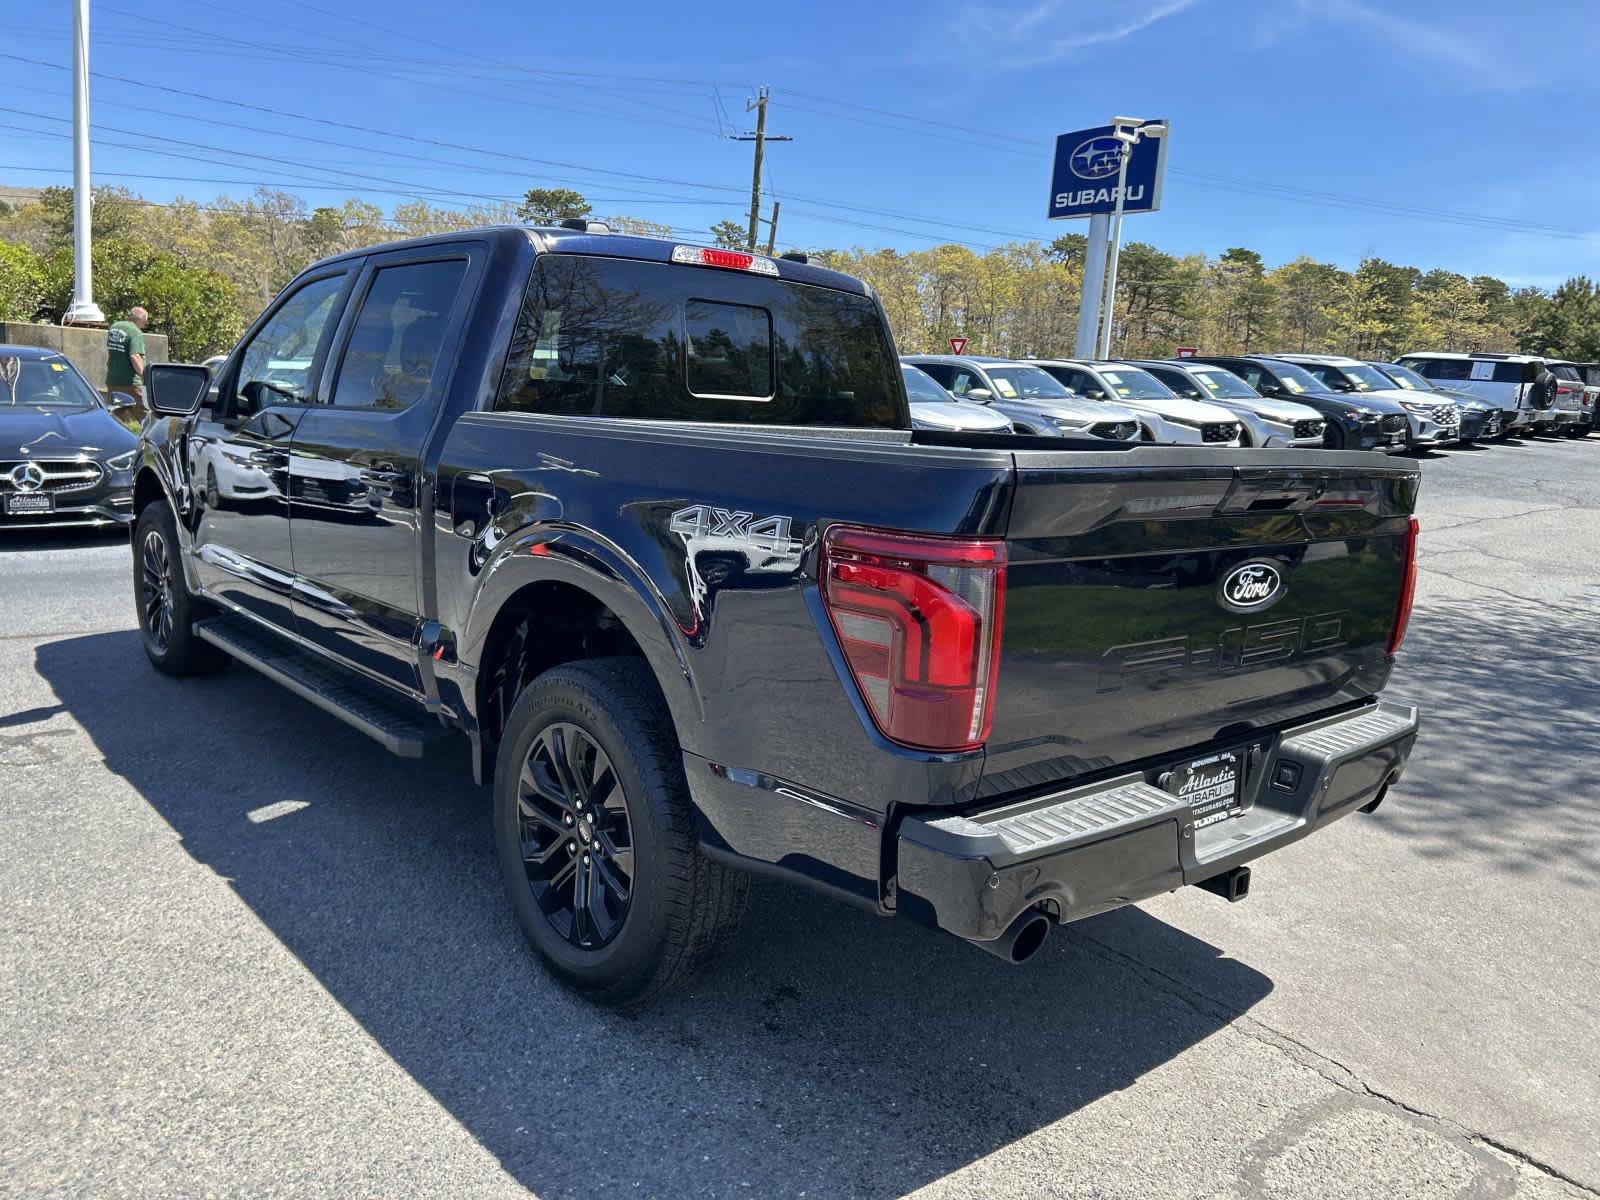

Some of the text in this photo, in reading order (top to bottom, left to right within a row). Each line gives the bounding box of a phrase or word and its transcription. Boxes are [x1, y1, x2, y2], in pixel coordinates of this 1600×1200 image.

[1055, 185, 1144, 208] SUBARU
[1234, 570, 1272, 600] Ford
[1179, 766, 1235, 795] Atlantic
[1182, 786, 1222, 804] UBARU
